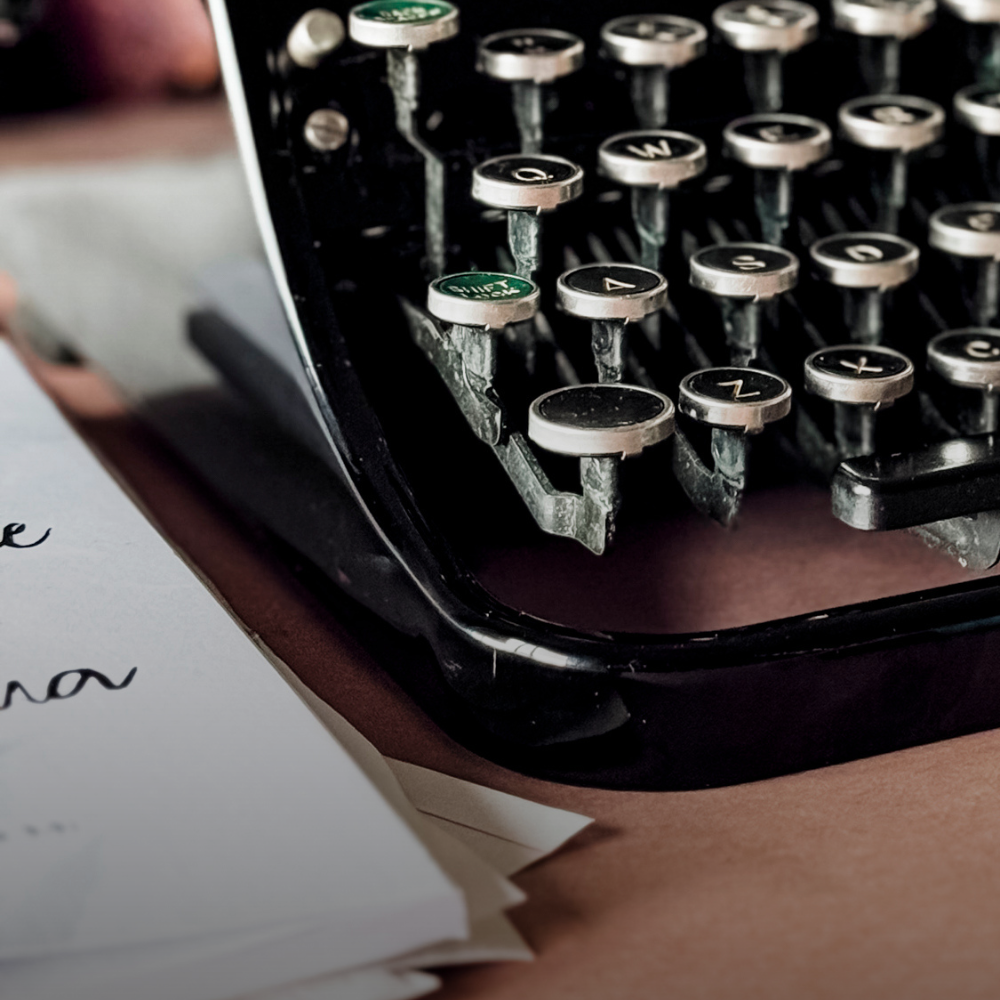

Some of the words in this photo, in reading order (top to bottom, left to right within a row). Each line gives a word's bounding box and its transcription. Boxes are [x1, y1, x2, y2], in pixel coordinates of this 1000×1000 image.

[627, 140, 672, 158] W
[512, 167, 553, 182] Q
[448, 279, 508, 294] SHIFT
[604, 277, 636, 291] A
[840, 356, 883, 375] X
[718, 379, 761, 399] Z
